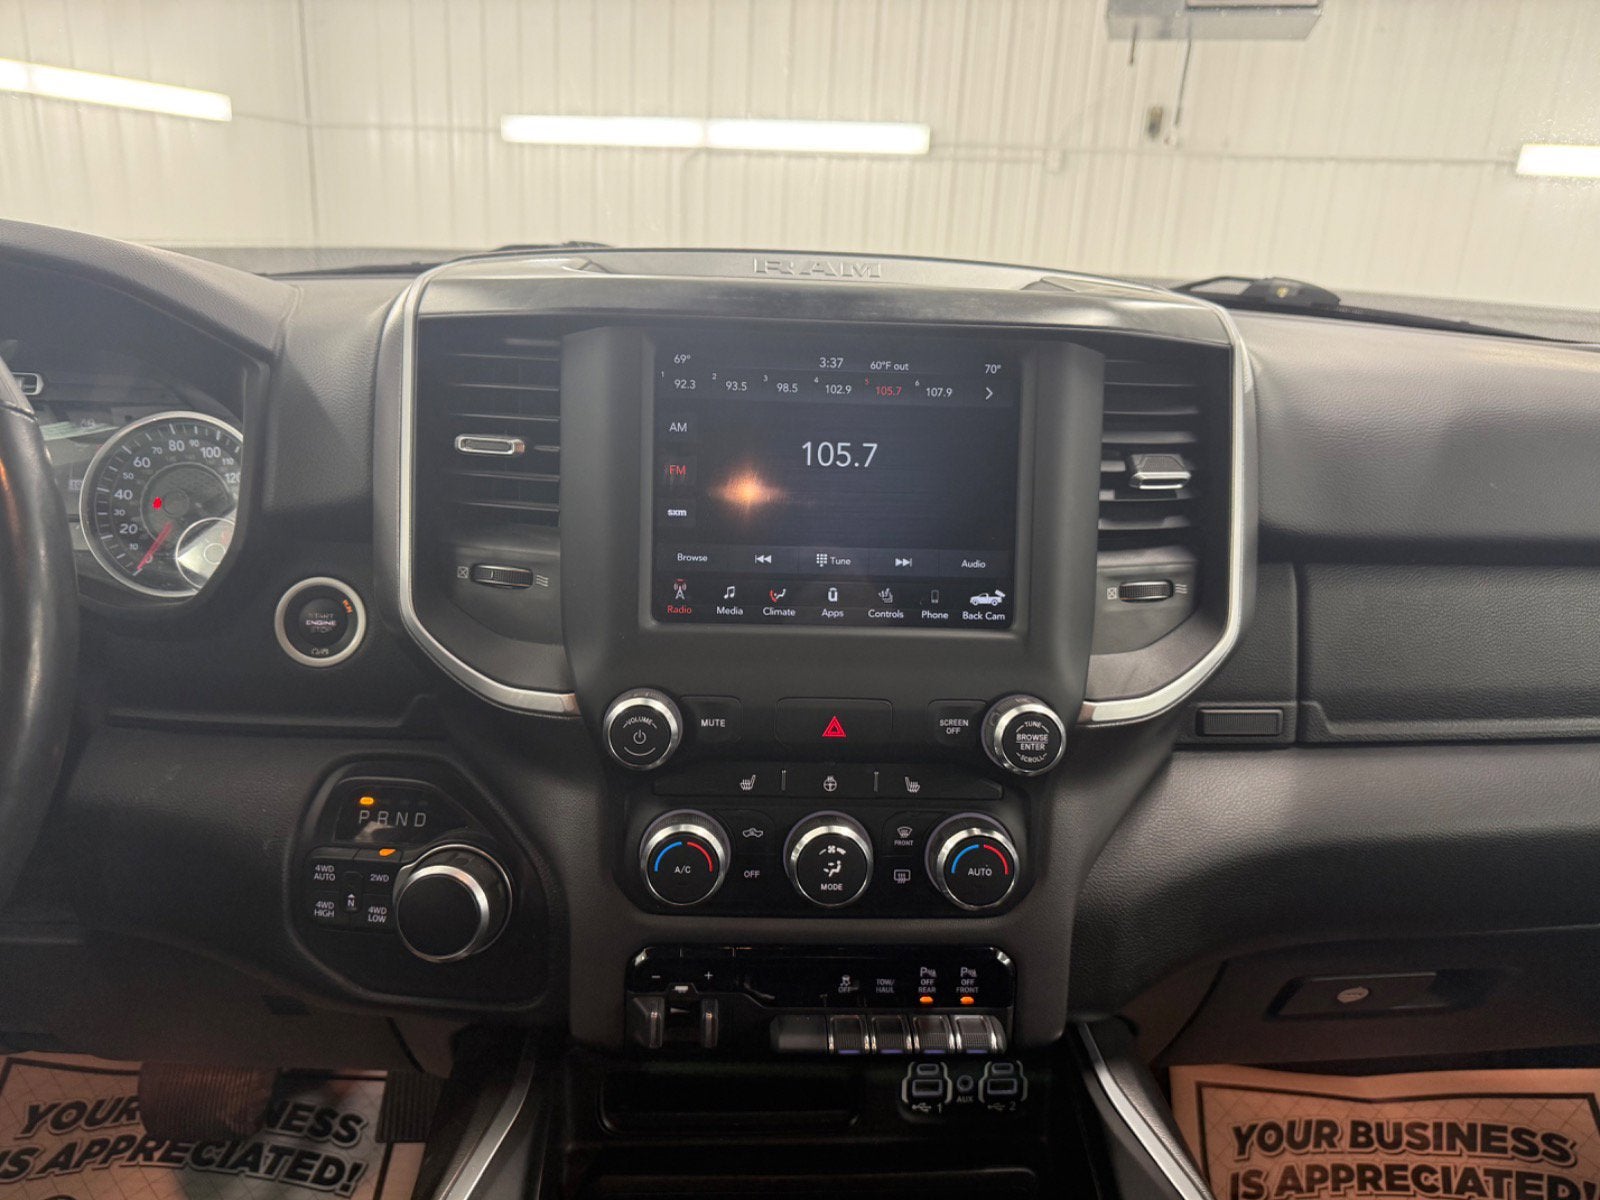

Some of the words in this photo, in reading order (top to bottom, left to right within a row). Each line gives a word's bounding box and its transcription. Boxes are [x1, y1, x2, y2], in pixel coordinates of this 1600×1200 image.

[753, 257, 882, 278] RAM
[819, 357, 844, 369] 3:37
[893, 362, 909, 371] out
[674, 379, 696, 390] 92.3
[725, 381, 747, 391] 93.5
[776, 383, 798, 393] 98.5
[825, 384, 852, 395] 102.9
[876, 385, 902, 396] 105.7
[926, 387, 953, 398] 107.9
[669, 422, 688, 432] AM
[168, 440, 185, 452] 80
[188, 440, 199, 448] 90
[152, 446, 163, 455] 70
[200, 447, 221, 458] 100
[801, 441, 878, 468] 105.7
[133, 457, 151, 468] 60
[669, 465, 687, 476] FM
[122, 472, 134, 480] 50
[114, 489, 133, 500] 40
[113, 509, 125, 517] 30
[667, 508, 687, 516] sxm
[120, 523, 138, 534] 20
[677, 553, 708, 563] Browse
[830, 557, 851, 566] Tune
[961, 559, 986, 569] Audio
[667, 605, 692, 614] Radio
[716, 606, 744, 616] Media
[763, 607, 796, 617] Climate
[821, 609, 844, 619] Apps
[868, 609, 904, 619] Controls
[921, 611, 949, 620] Phone
[962, 611, 982, 621] Back
[983, 612, 1005, 621] Cam
[626, 716, 653, 726] VOLUME
[701, 719, 726, 728] MUTE
[939, 719, 969, 727] SCREEN
[946, 727, 961, 735] OFF
[1020, 743, 1045, 751] ENTER
[1020, 754, 1045, 763] SCROLL
[893, 839, 914, 847] FRONT
[315, 864, 335, 873] 4WD
[673, 865, 691, 875] A/C
[967, 868, 993, 877] AUTO
[313, 872, 336, 881] AUTO
[370, 873, 390, 882] 2WD
[744, 870, 760, 879] OFF
[821, 883, 843, 892] MODE
[315, 900, 335, 909] 4WD
[347, 899, 355, 907] N
[314, 909, 335, 918] HIGH
[368, 906, 387, 915] 4WD
[367, 913, 387, 923] LOW
[937, 1102, 942, 1113] 1
[1009, 1101, 1017, 1111] 2
[19, 1095, 141, 1136] YOUR
[1231, 1118, 1341, 1160] YOUR
[1349, 1119, 1578, 1167] BUSINESS
[33, 1134, 366, 1194] APPRECIATED!
[1230, 1168, 1268, 1200] IS
